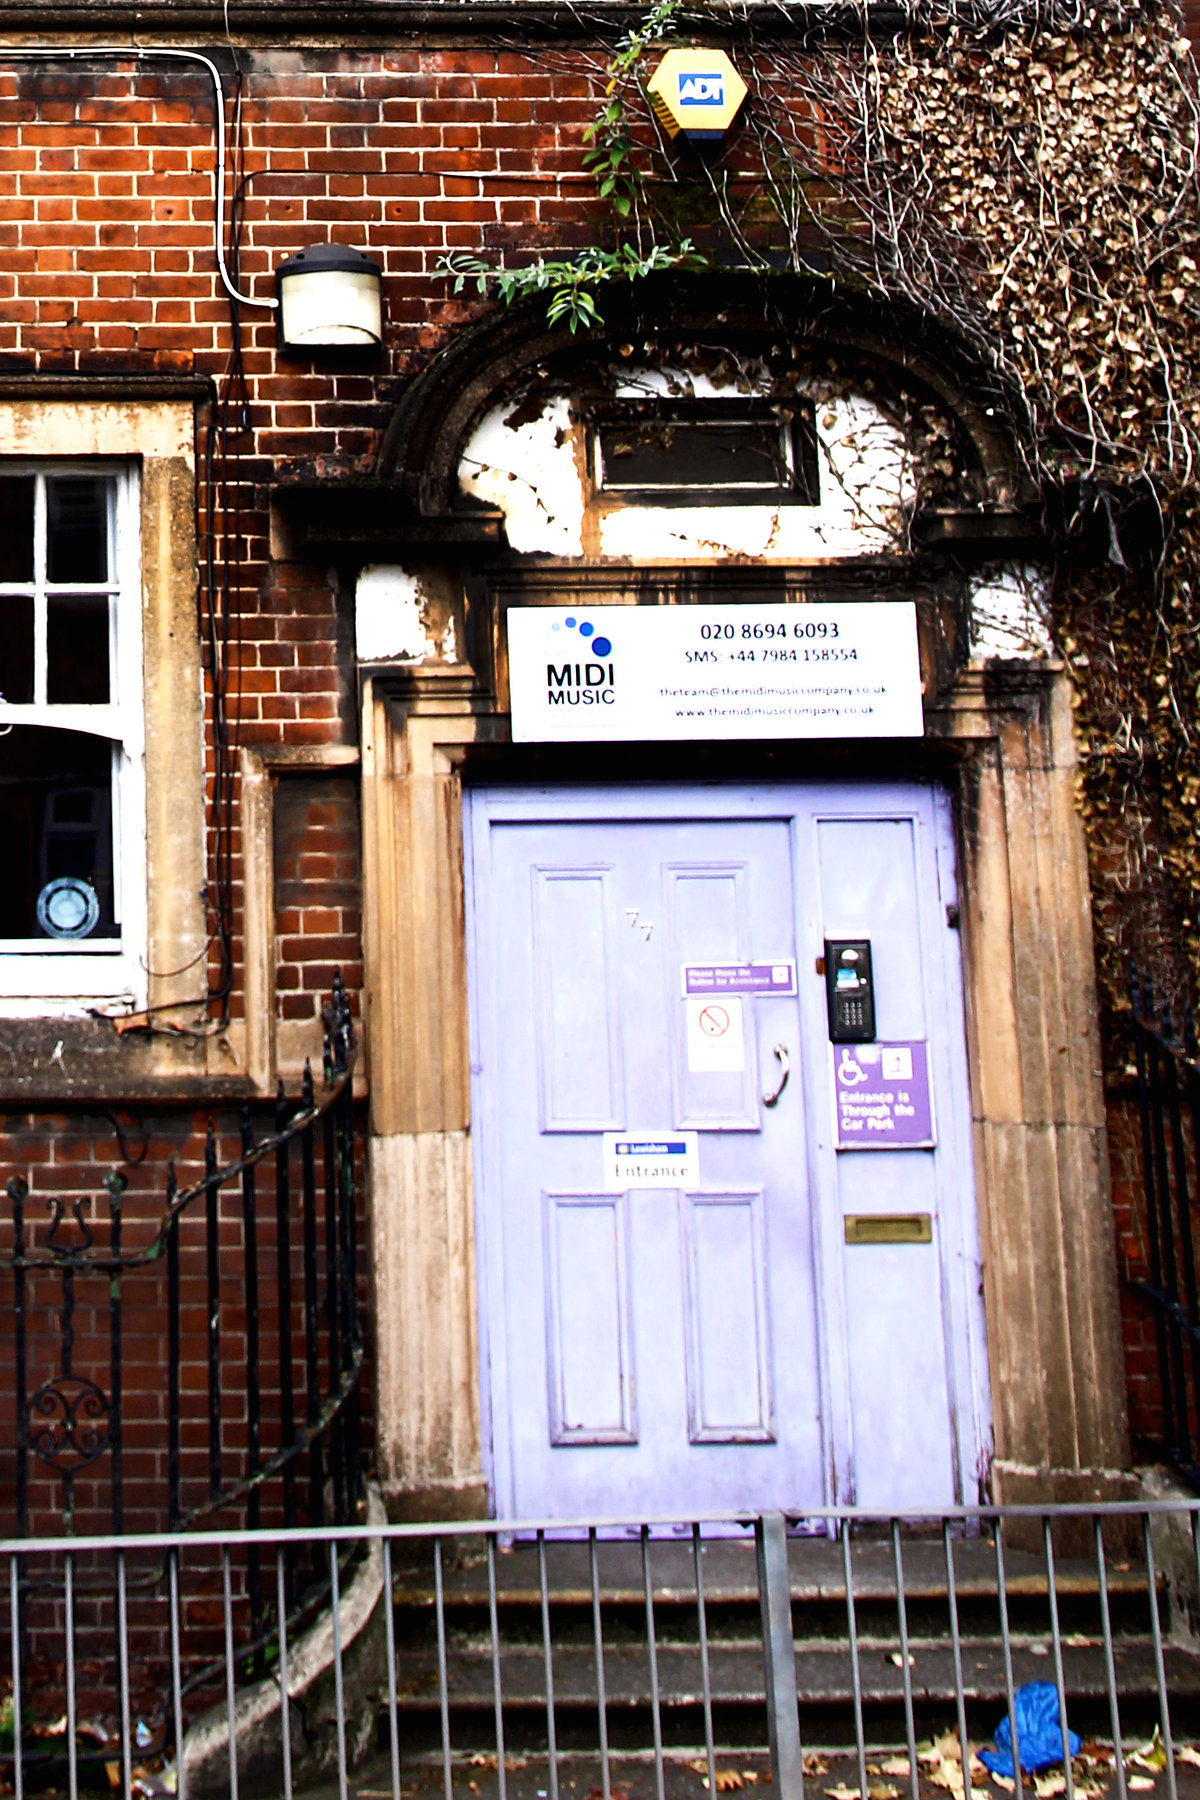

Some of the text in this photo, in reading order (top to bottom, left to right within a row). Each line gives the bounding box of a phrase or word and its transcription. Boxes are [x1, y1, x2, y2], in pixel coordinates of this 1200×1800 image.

[680, 78, 722, 100] ADT
[700, 622, 840, 640] 020 8694 6093
[729, 650, 756, 662] +44
[761, 649, 797, 662] 7984
[803, 649, 858, 662] 158554
[546, 663, 615, 687] MIDI
[548, 689, 616, 705] MUSIC
[840, 1091, 894, 1104] Entrance
[842, 1104, 915, 1119] Through the
[841, 1117, 895, 1131] Car Park
[615, 1164, 688, 1177] Entrance
